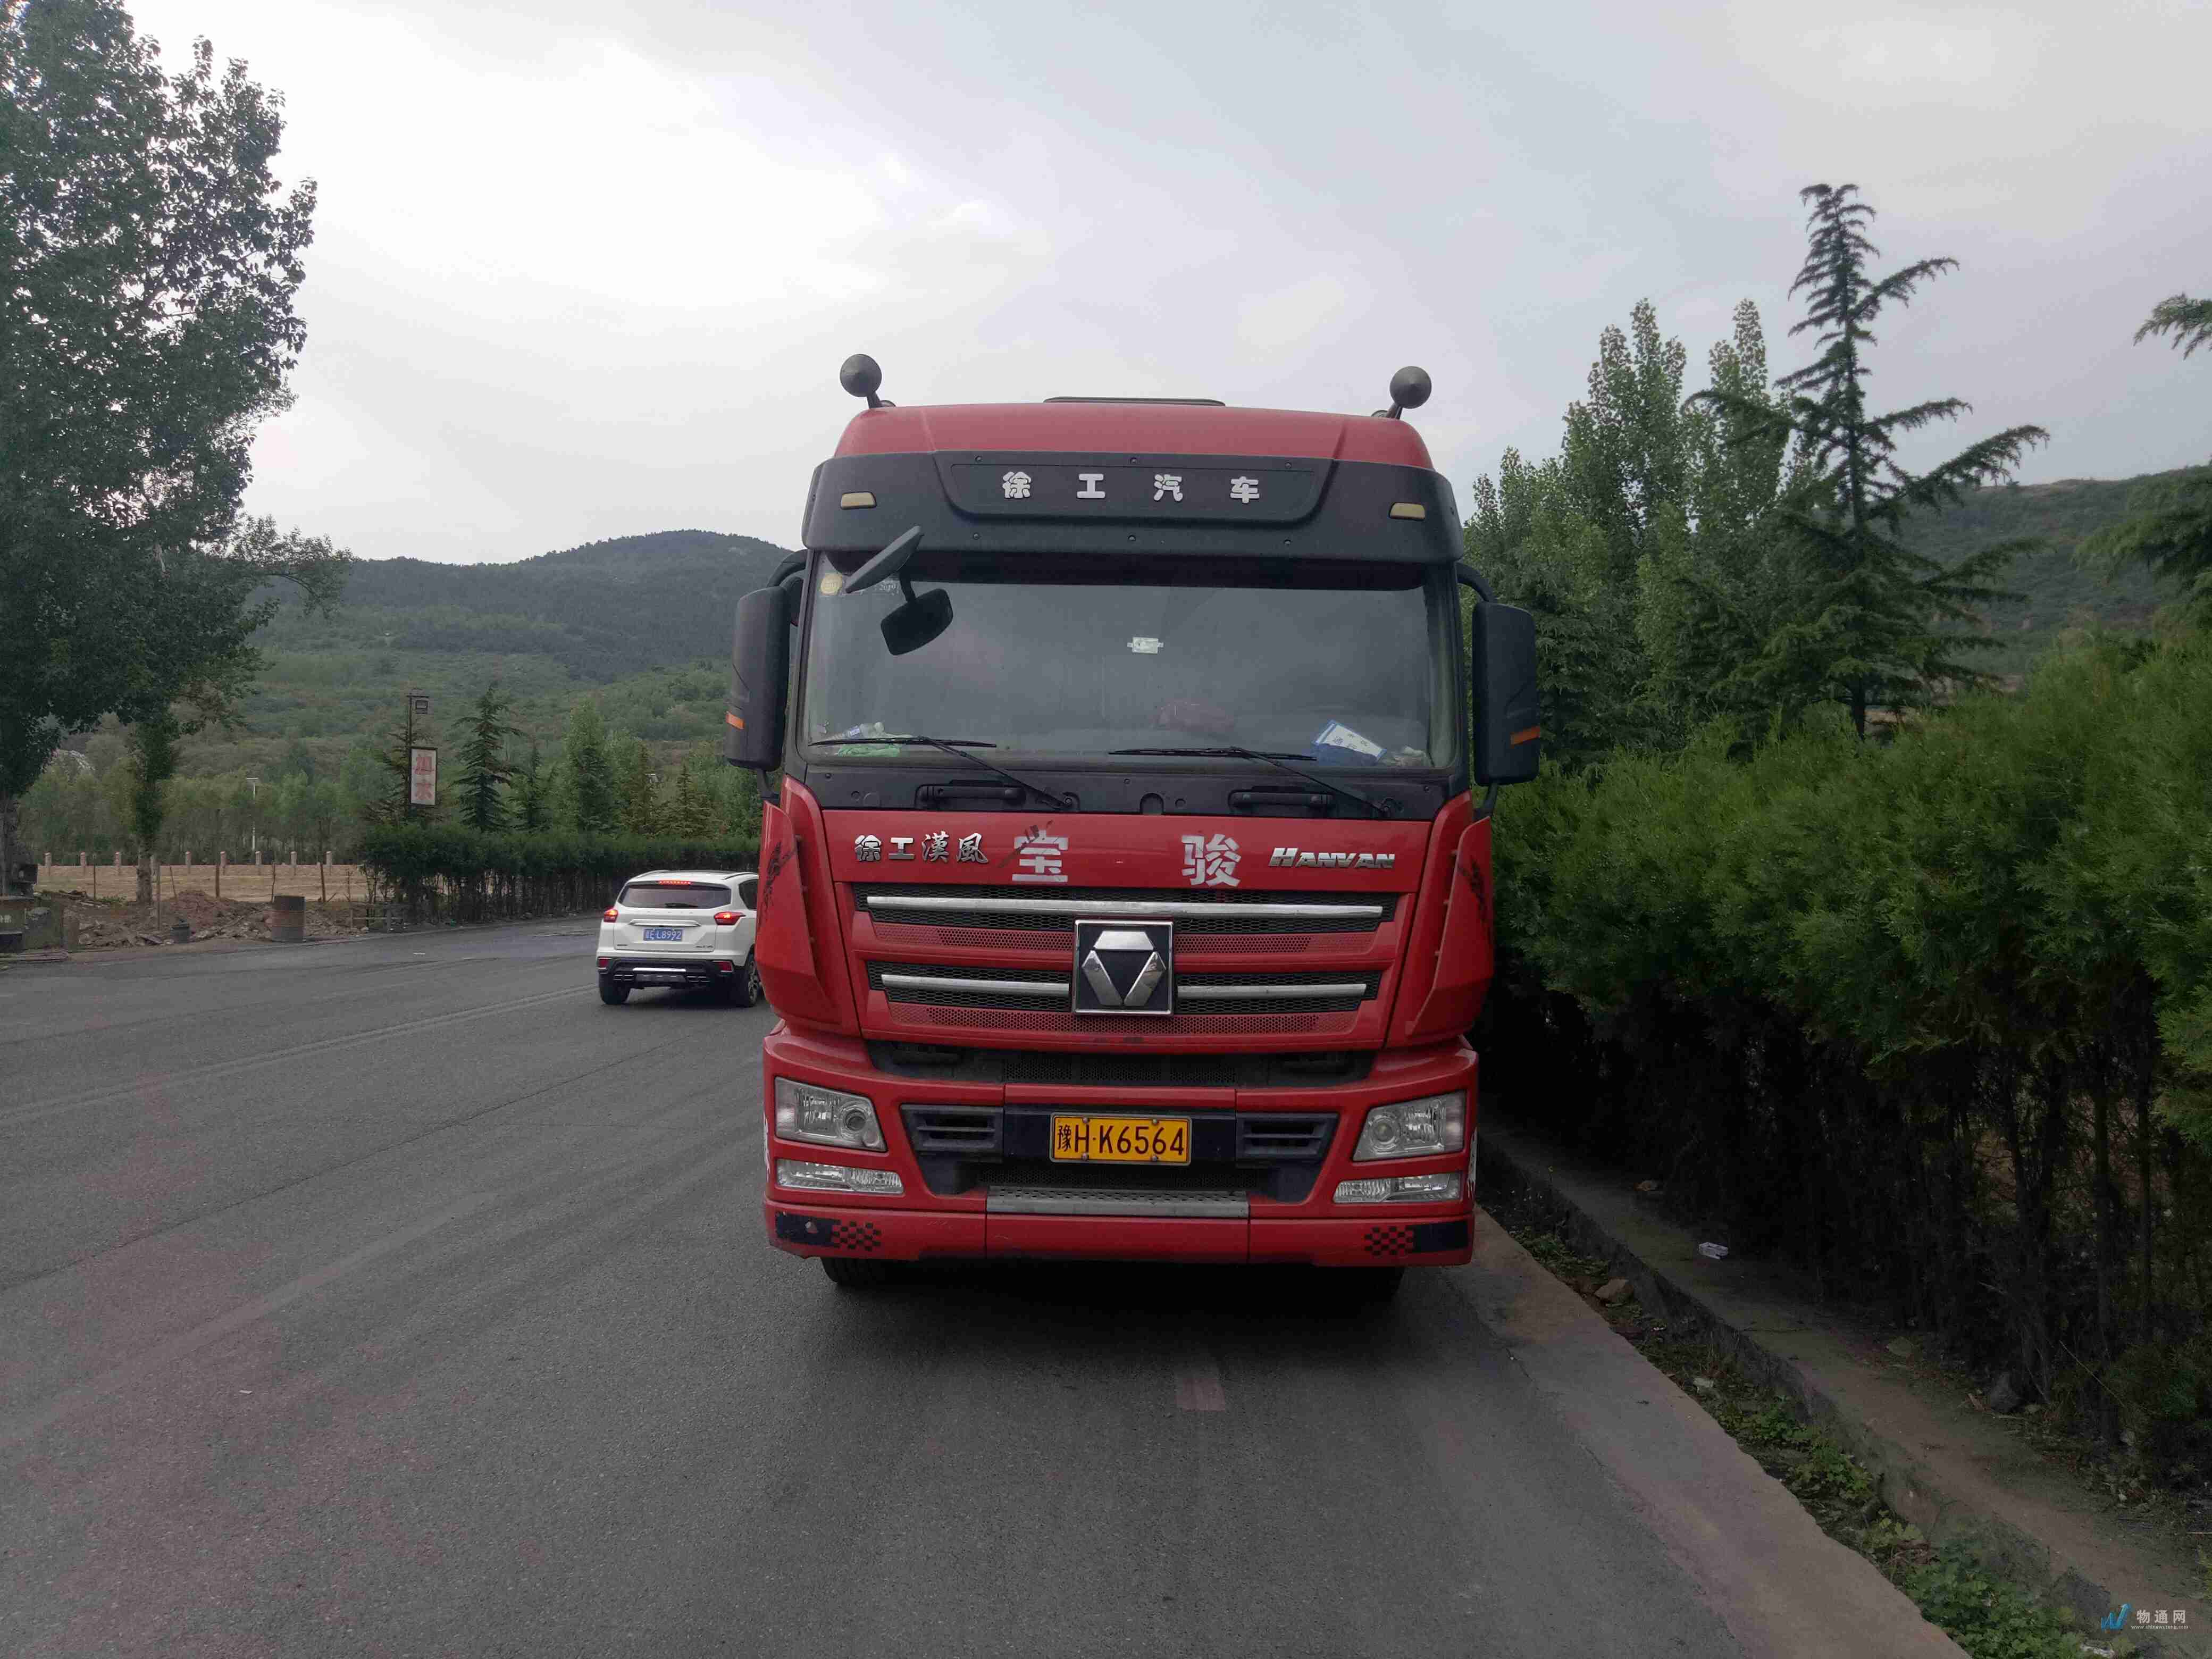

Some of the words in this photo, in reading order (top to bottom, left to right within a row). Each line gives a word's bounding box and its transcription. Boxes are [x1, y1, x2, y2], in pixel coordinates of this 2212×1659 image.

[1002, 472, 1260, 504] 徐工汽车
[646, 930, 681, 940] EL8992
